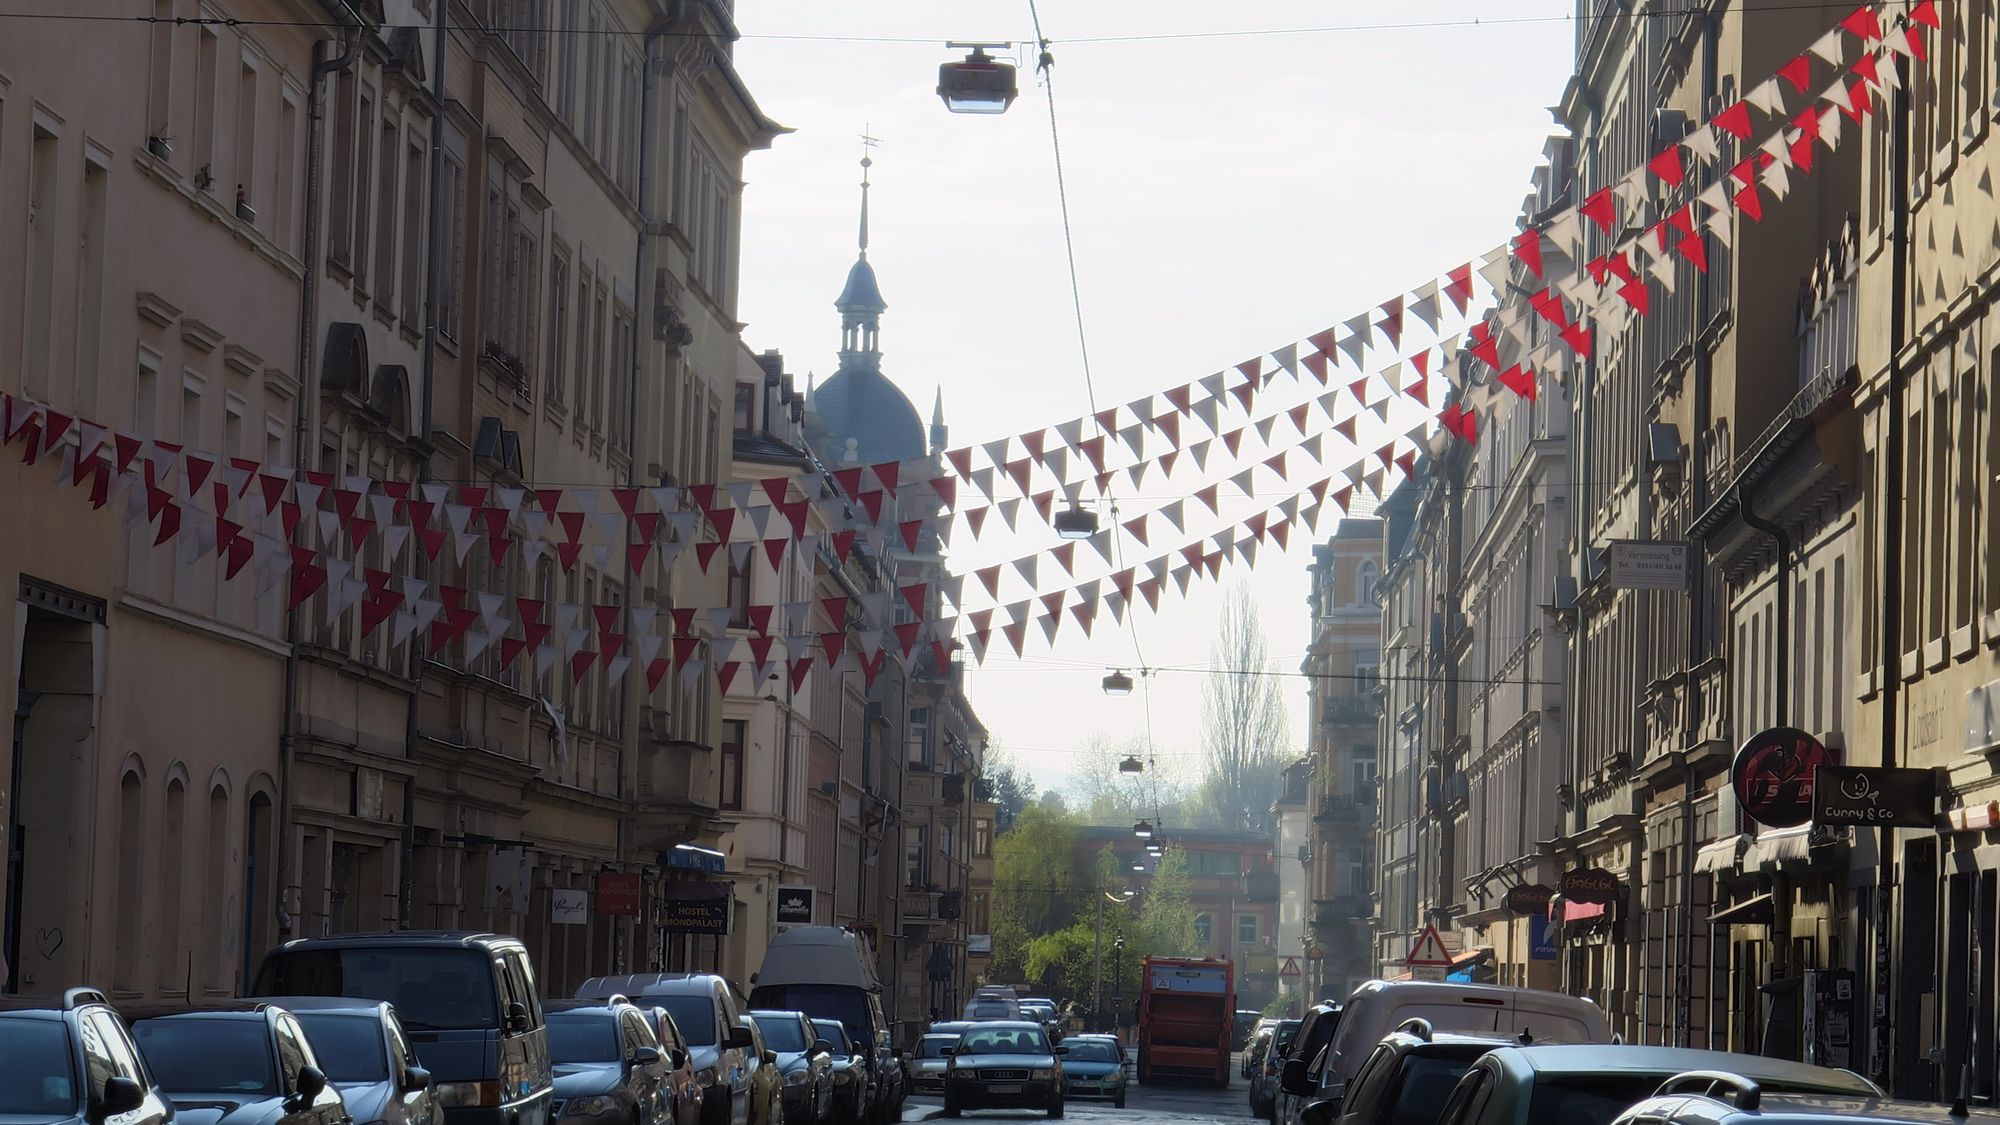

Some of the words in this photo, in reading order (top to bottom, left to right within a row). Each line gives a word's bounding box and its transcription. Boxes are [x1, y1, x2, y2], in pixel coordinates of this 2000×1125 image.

[1627, 551, 1670, 562] Vermietung
[1825, 806, 1864, 821] Curry
[1866, 807, 1875, 821] &
[1878, 808, 1894, 819] Co
[678, 906, 711, 916] HOSTEL
[667, 917, 724, 928] MONDPALAST
